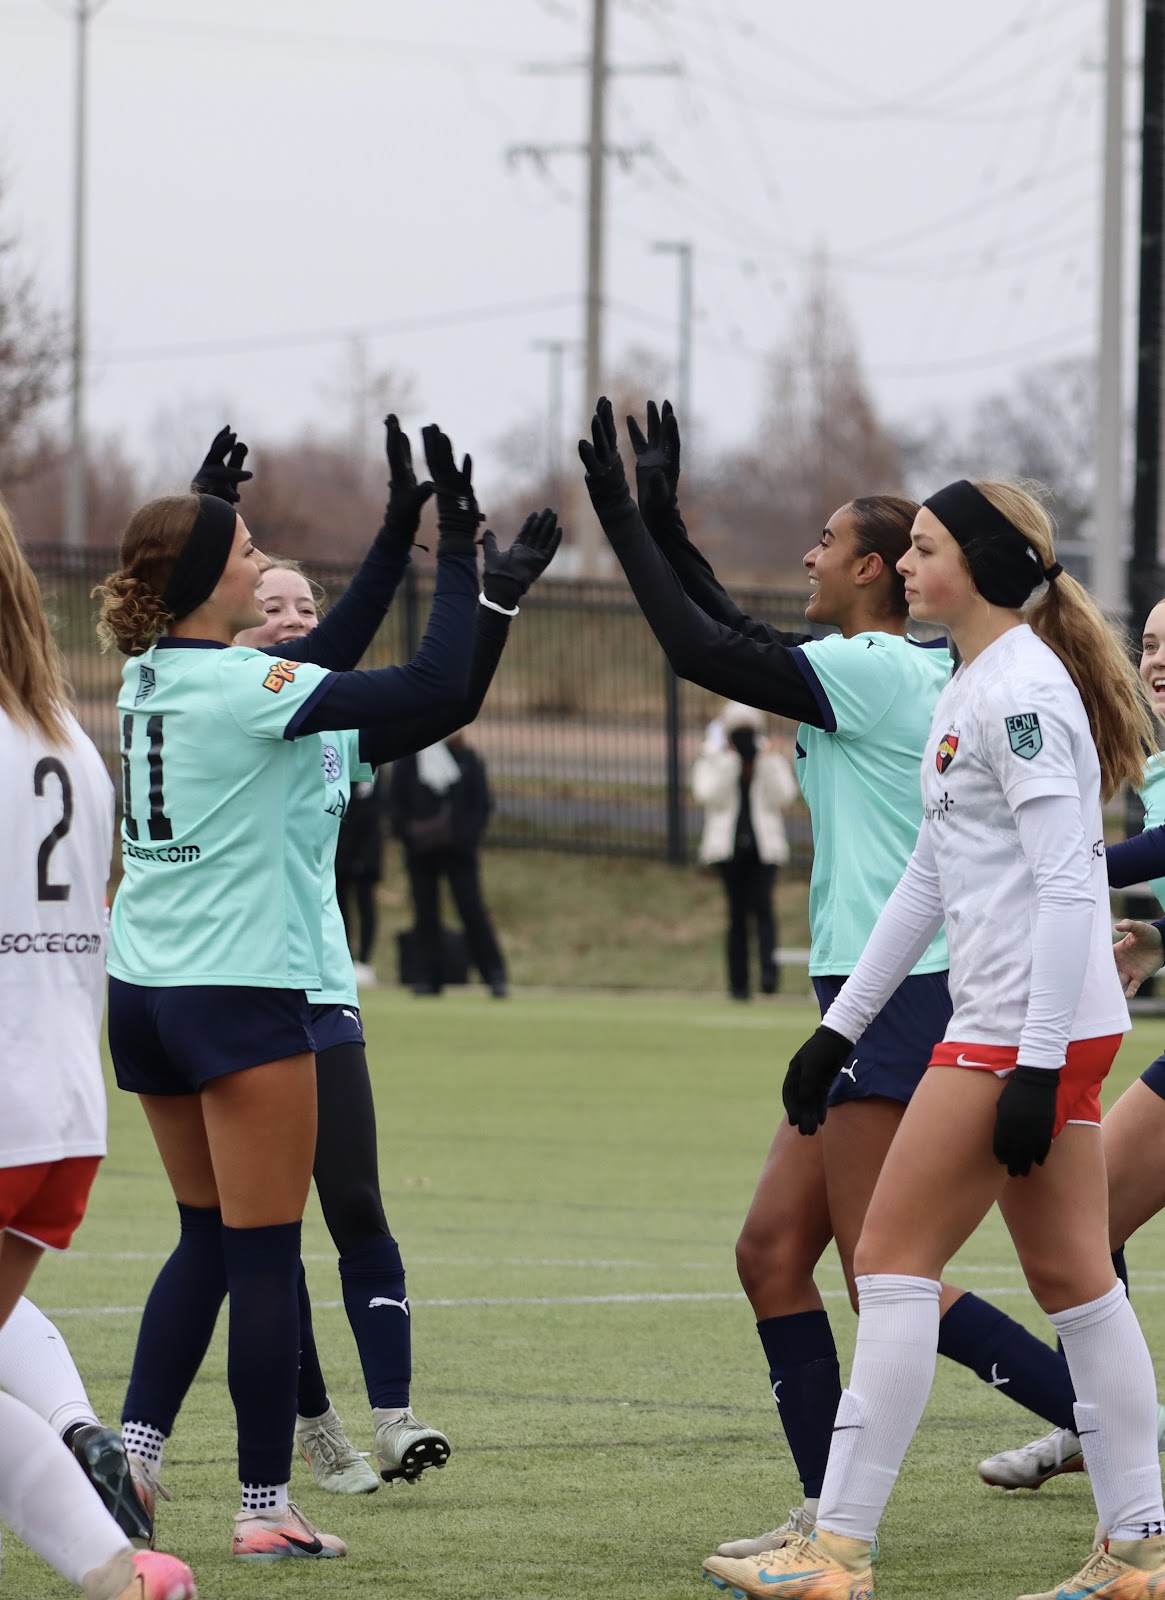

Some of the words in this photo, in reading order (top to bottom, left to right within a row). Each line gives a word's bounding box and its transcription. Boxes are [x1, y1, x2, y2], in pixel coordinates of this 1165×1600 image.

[121, 714, 173, 840] 11
[1007, 714, 1038, 732] ECNL
[34, 756, 74, 901] 2
